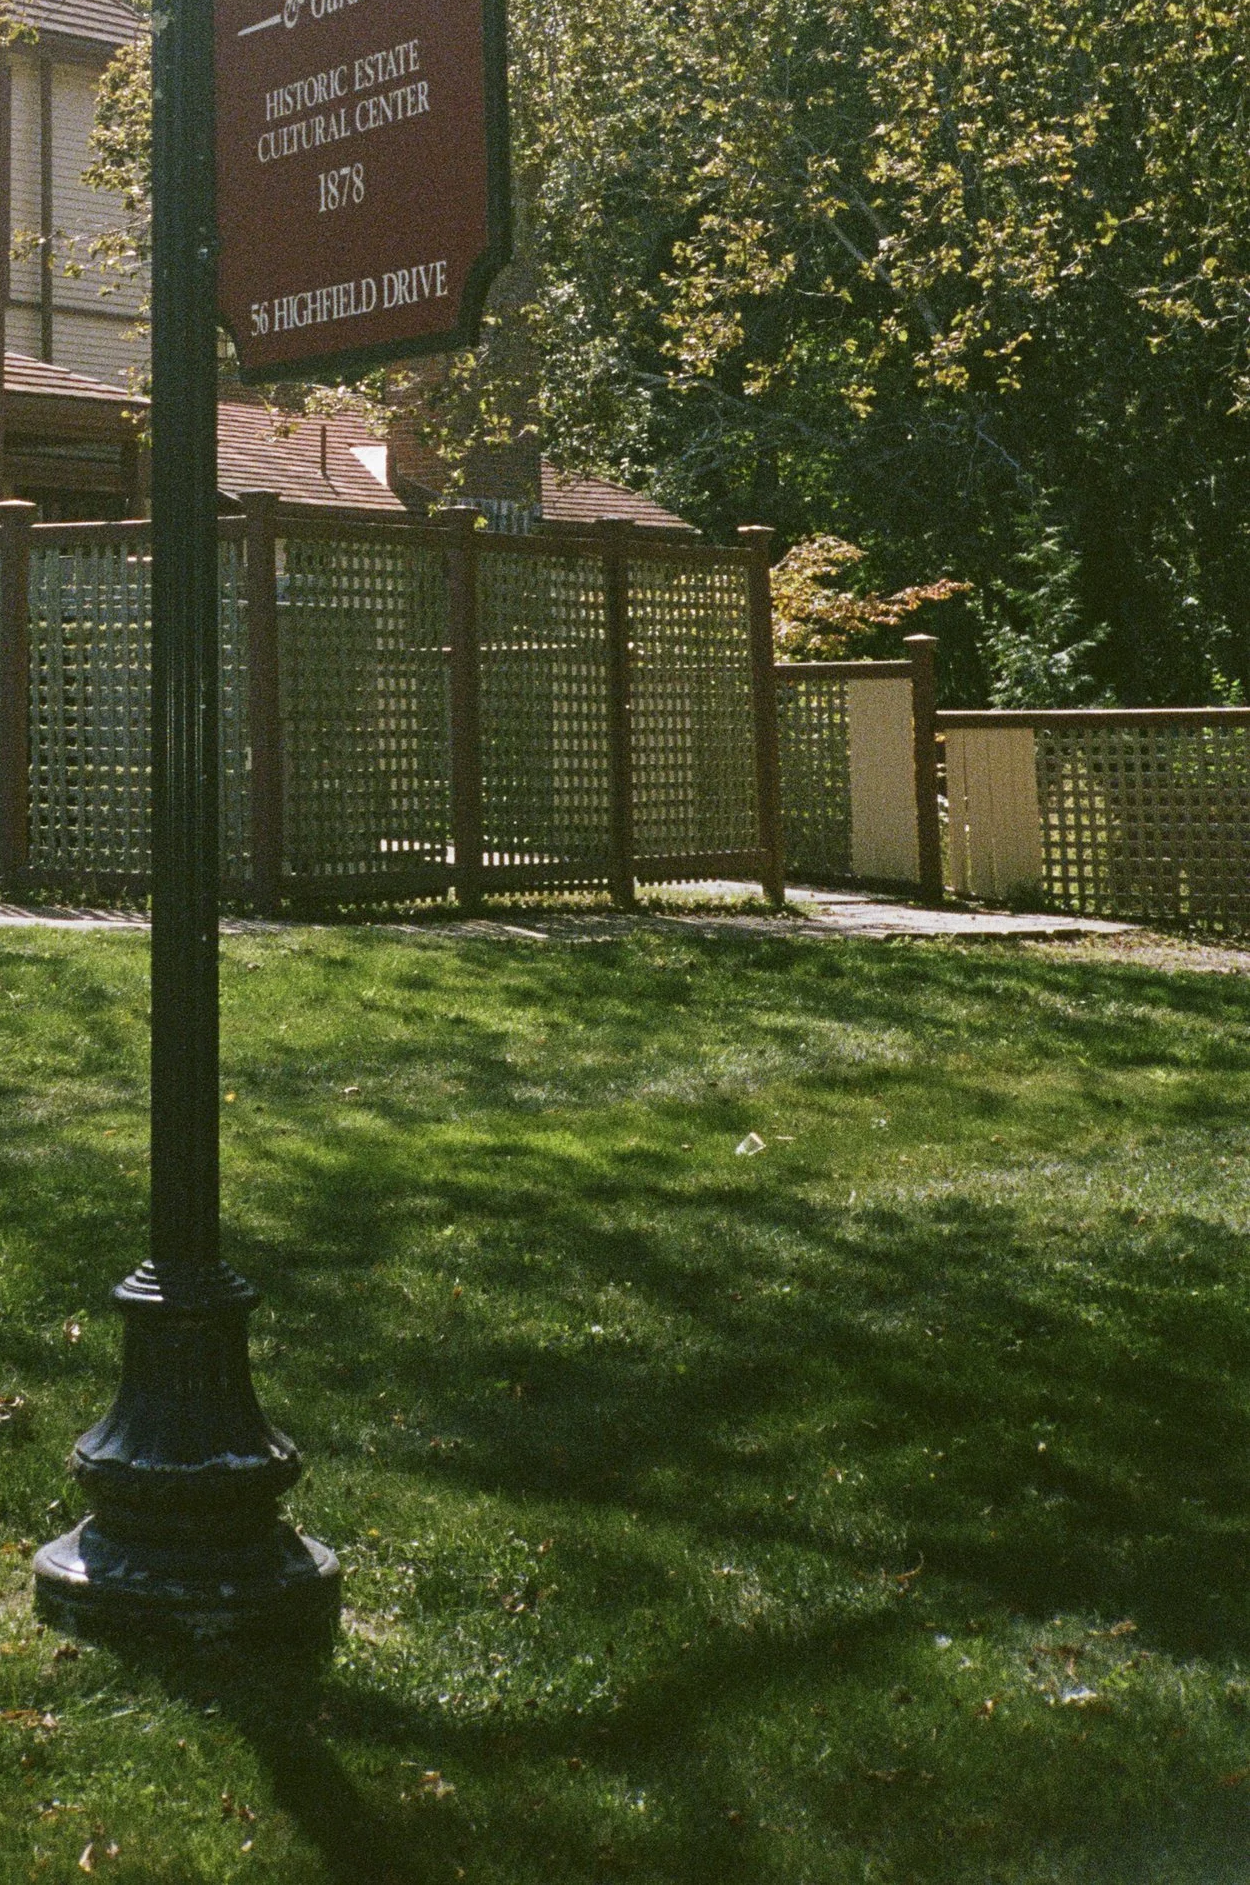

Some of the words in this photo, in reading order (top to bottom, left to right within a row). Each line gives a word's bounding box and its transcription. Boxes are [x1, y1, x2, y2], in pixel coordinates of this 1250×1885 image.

[265, 65, 348, 121] HISTORIC
[354, 39, 420, 92] ESTATE
[257, 107, 350, 163] CULTURAL
[355, 80, 430, 132] CENTER
[318, 162, 365, 214] 1878
[251, 303, 268, 336] 56
[273, 277, 377, 332] HIGHFIELD
[382, 260, 448, 309] DRIVE
